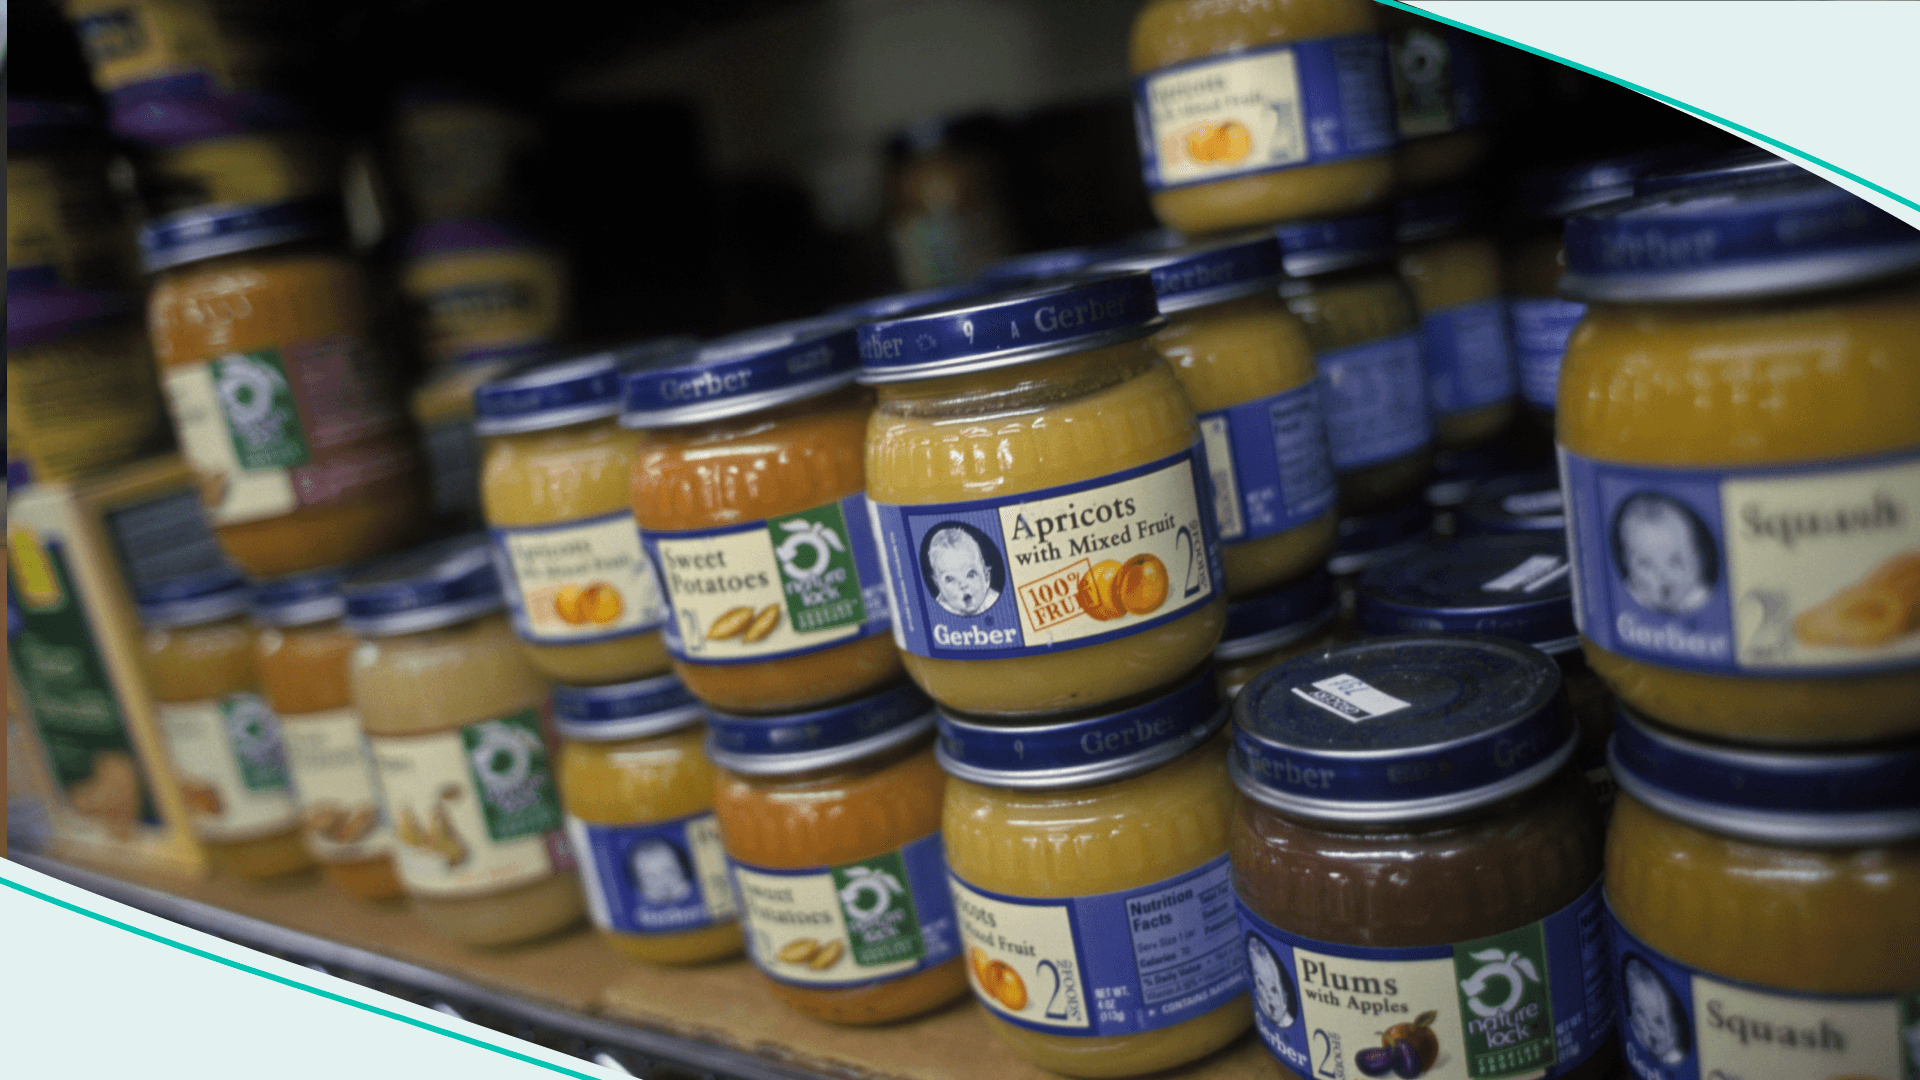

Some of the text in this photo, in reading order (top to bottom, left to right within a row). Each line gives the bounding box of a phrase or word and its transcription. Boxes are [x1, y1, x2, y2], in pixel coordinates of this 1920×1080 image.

[1034, 295, 1126, 333] Gerber
[660, 368, 752, 401] Gerber
[1011, 496, 1137, 543] Apricots
[1014, 513, 1176, 567] with Mixed Fruit
[664, 547, 727, 572] Sweet
[1175, 524, 1201, 599] 2
[671, 568, 771, 596] Potatoes
[934, 623, 1017, 646] Gerber
[1130, 888, 1194, 917] Nutrition
[1133, 913, 1173, 933] Facts
[998, 935, 1036, 957] Fruit
[1036, 958, 1068, 1020] 2
[1300, 957, 1398, 996] Plums
[1305, 988, 1409, 1016] with Apples
[1468, 1001, 1540, 1035] nature
[1485, 1022, 1531, 1050] lock
[1706, 999, 1847, 1052] Squash
[1313, 1028, 1337, 1080] 2
